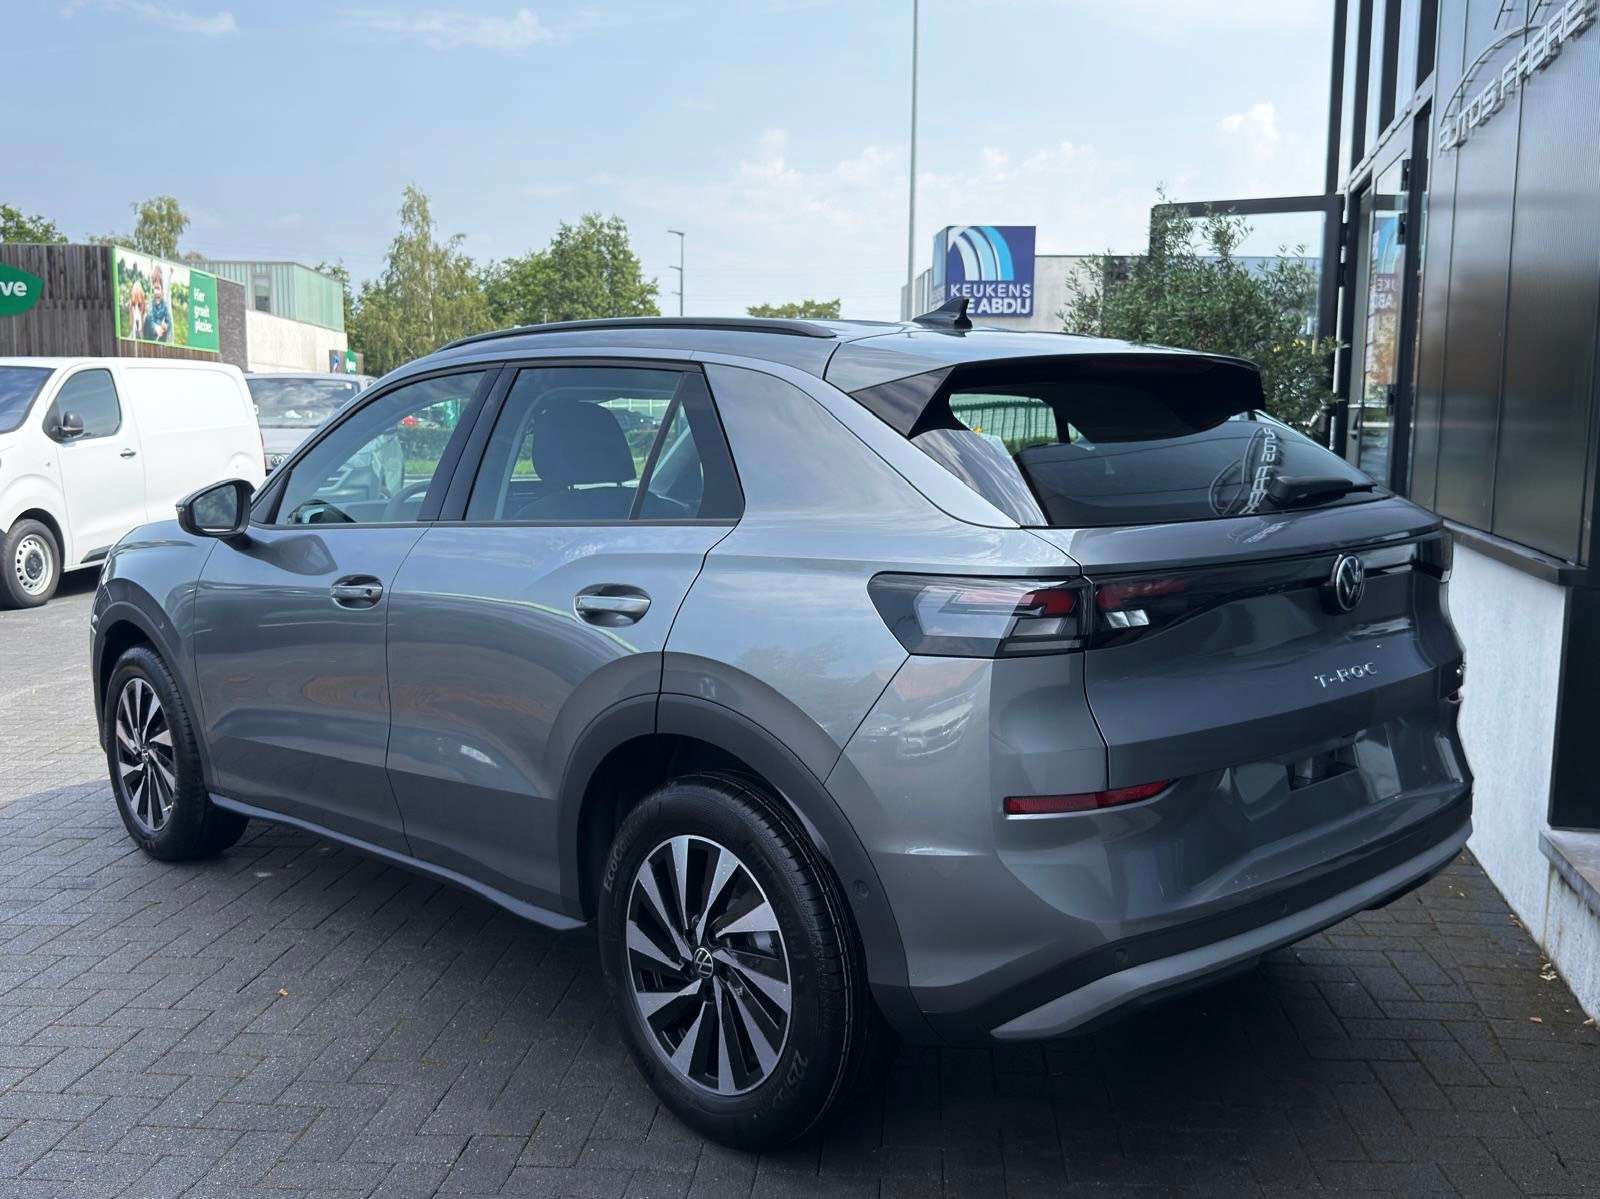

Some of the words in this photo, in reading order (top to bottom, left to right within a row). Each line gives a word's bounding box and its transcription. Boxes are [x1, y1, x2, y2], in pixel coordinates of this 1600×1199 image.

[0, 281, 27, 297] ve
[950, 284, 1032, 297] KEUKENS
[977, 298, 1031, 314] ABDIJ
[1314, 662, 1378, 688] T-ROC
